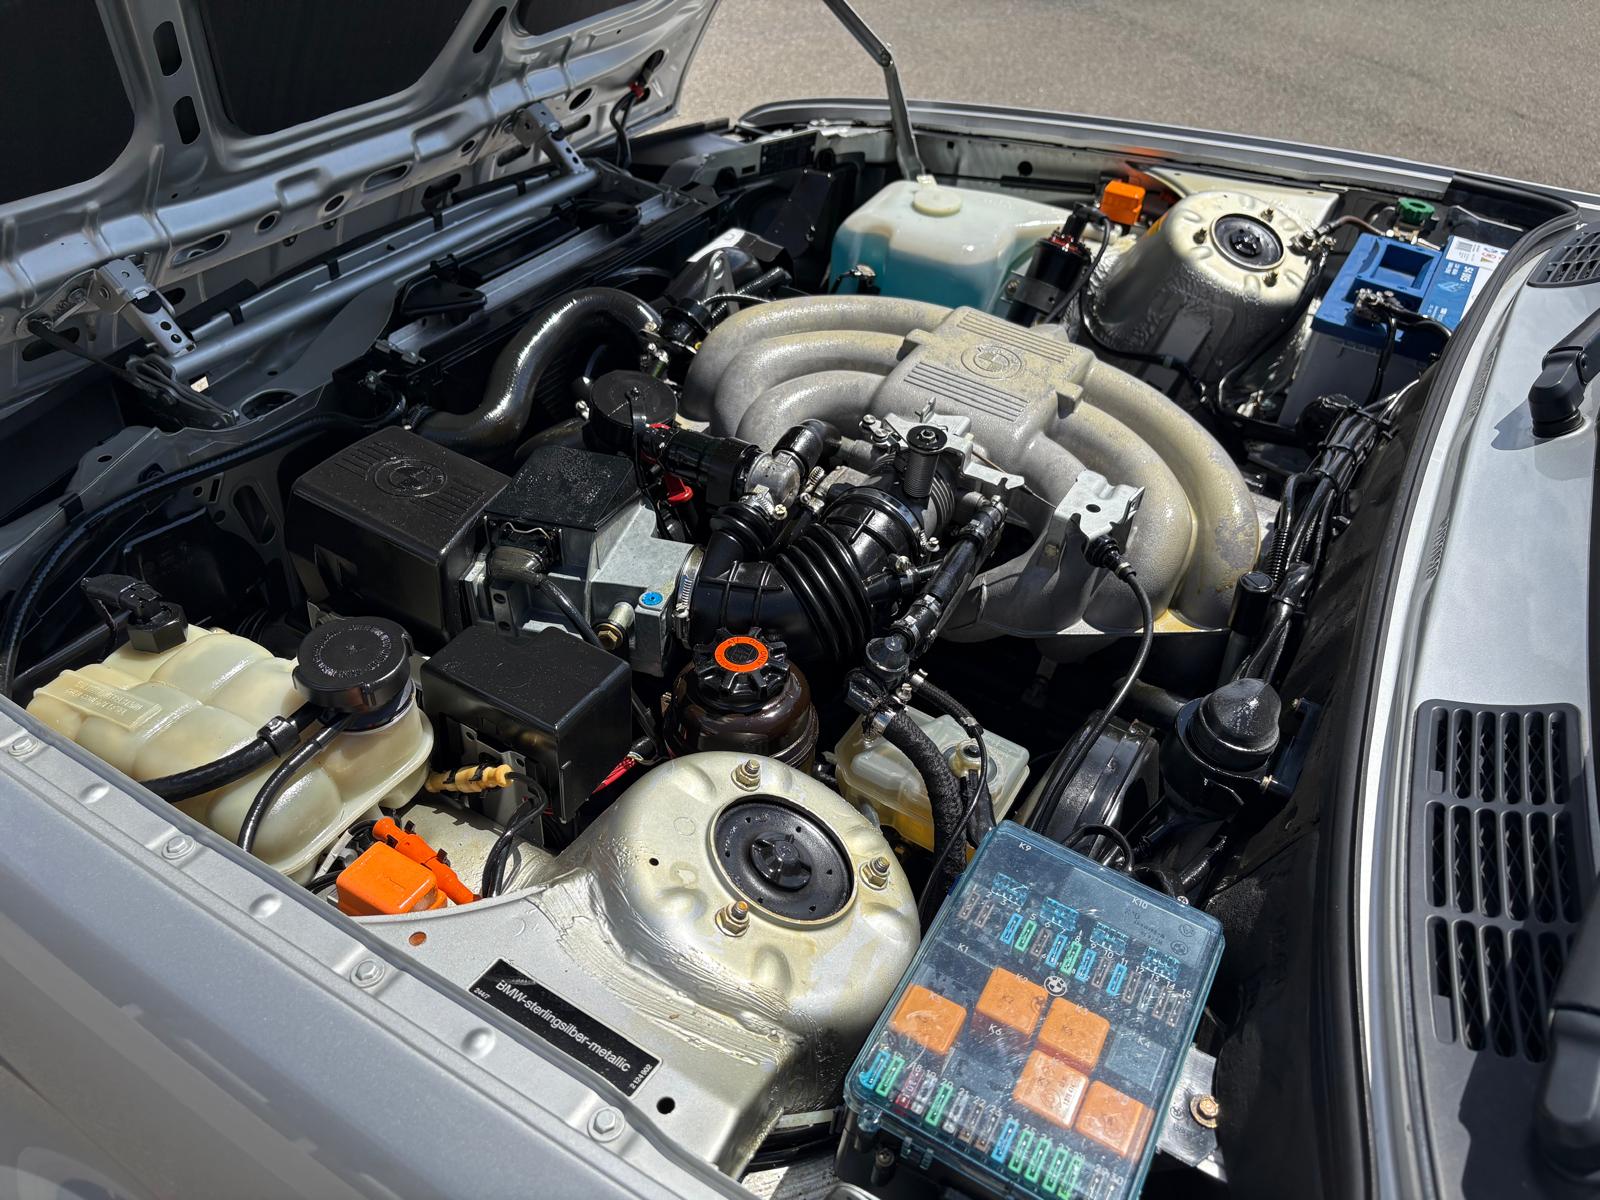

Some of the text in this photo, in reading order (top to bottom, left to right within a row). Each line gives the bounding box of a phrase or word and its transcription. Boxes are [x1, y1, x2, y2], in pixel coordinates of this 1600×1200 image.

[1019, 842, 1032, 852] K9
[1132, 897, 1148, 909] K10
[957, 943, 969, 953] K1
[1044, 920, 1051, 928] 6
[1104, 950, 1114, 959] 10
[1120, 957, 1129, 966] 11
[1135, 966, 1145, 975] 12
[1150, 973, 1160, 983] 13
[1165, 981, 1176, 990] 14
[1182, 989, 1192, 998] 15
[495, 979, 631, 1073] BMW-sterlingsilber-metallic
[989, 1024, 1002, 1036] K6
[1137, 1035, 1150, 1048] K4
[958, 1088, 969, 1097] 21
